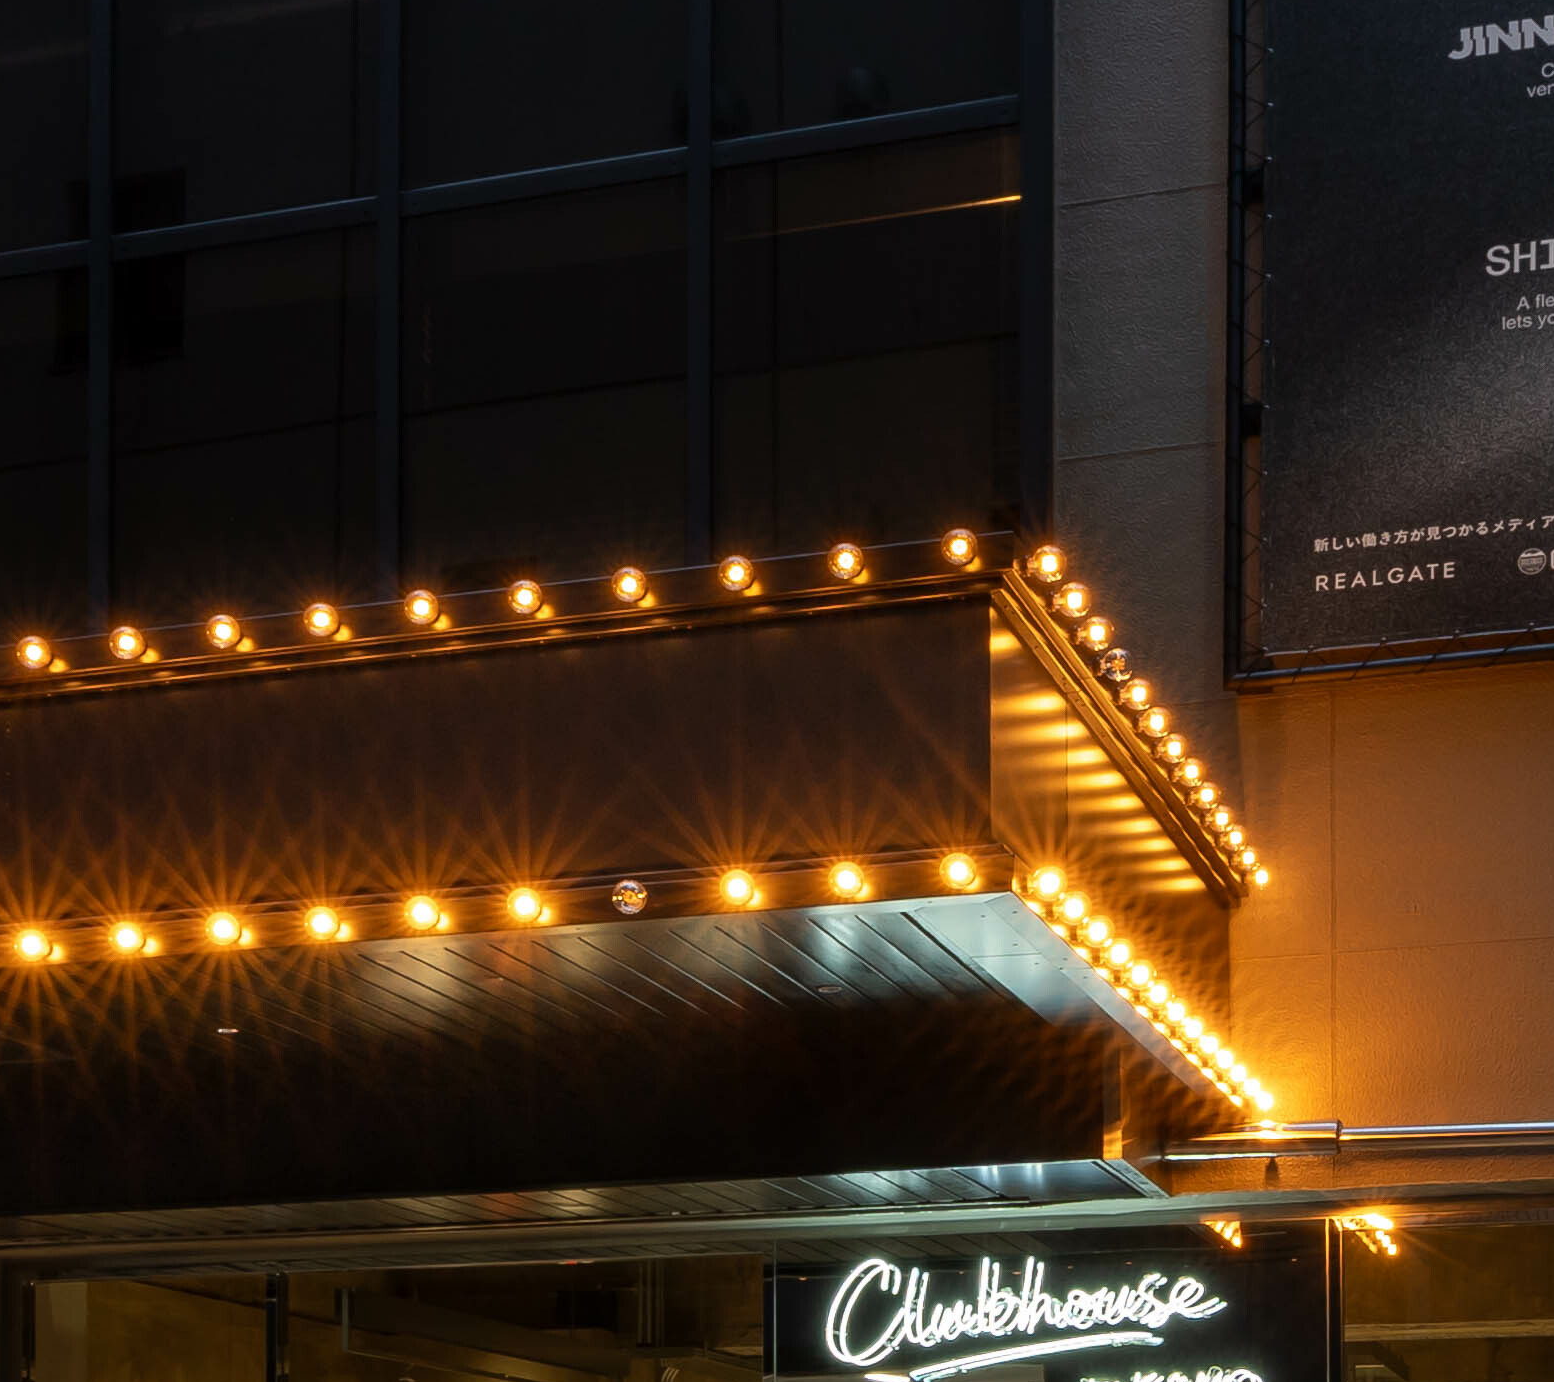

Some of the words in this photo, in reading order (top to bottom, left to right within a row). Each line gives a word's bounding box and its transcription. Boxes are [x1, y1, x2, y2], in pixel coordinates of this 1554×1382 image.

[1515, 295, 1531, 311] A
[1501, 315, 1534, 332] lets
[1314, 560, 1458, 594] REALGATE
